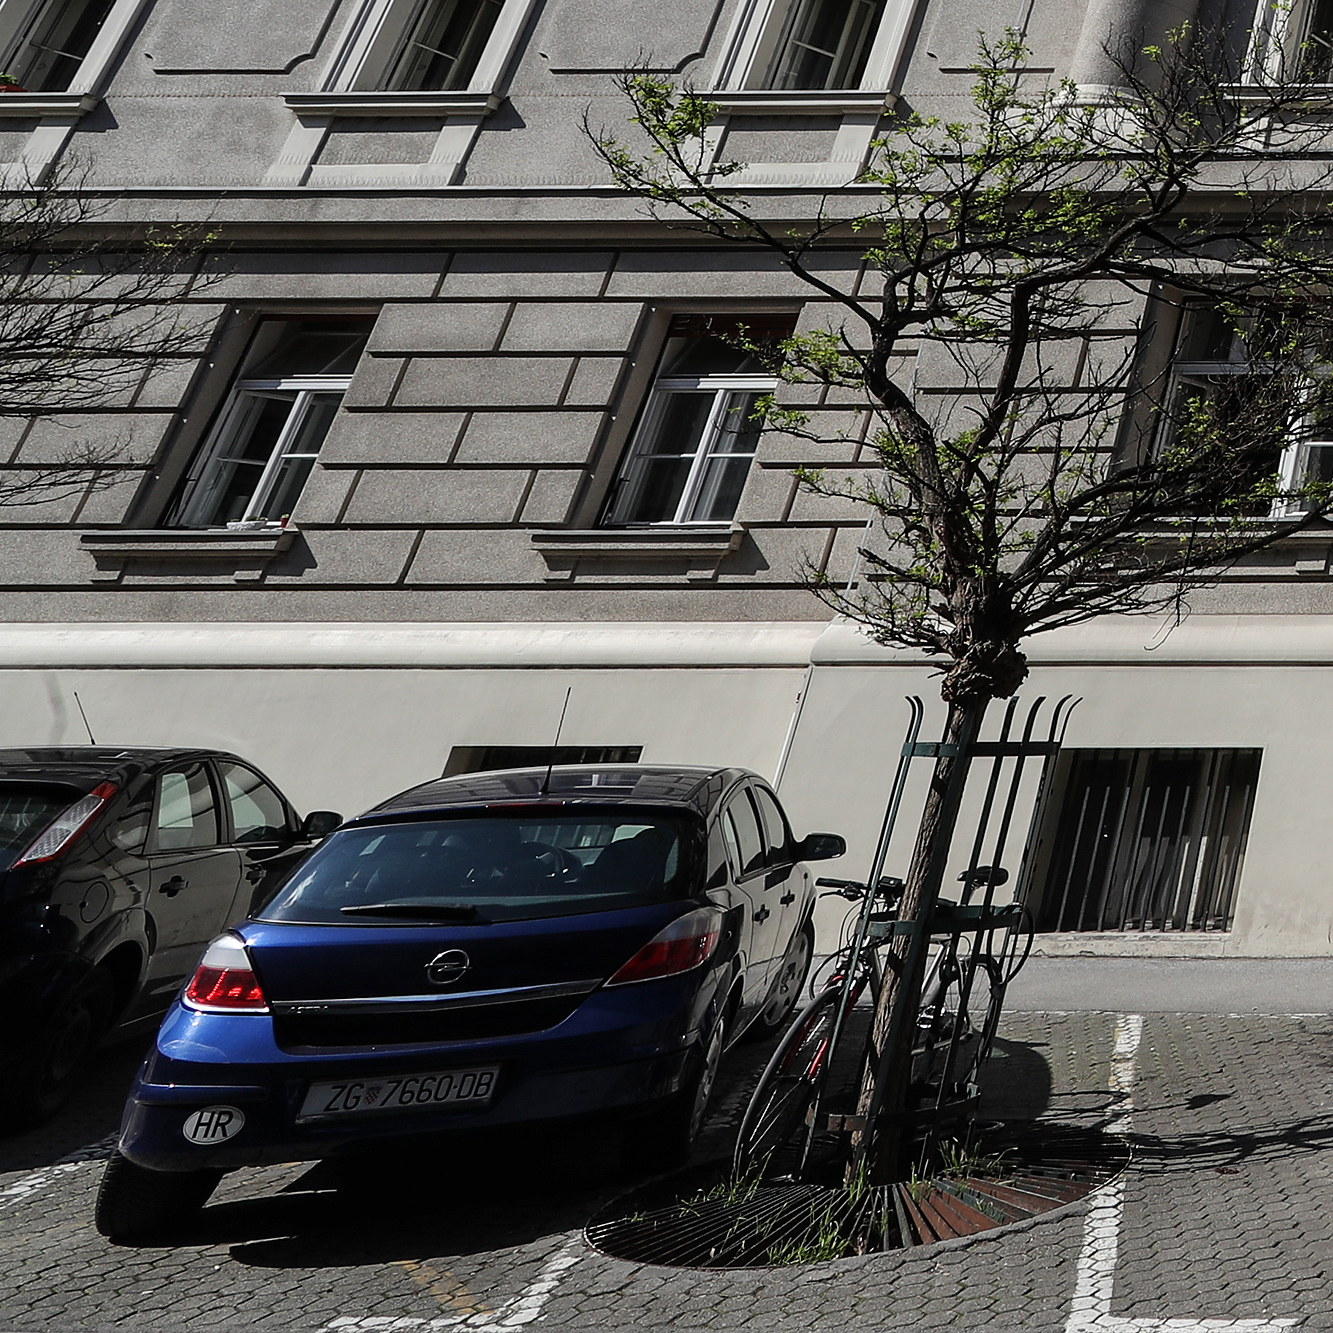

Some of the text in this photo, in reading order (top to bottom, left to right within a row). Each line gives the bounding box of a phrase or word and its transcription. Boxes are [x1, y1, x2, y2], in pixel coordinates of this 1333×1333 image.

[323, 1071, 496, 1113] ZG 7660-DB
[192, 1110, 235, 1139] HR
